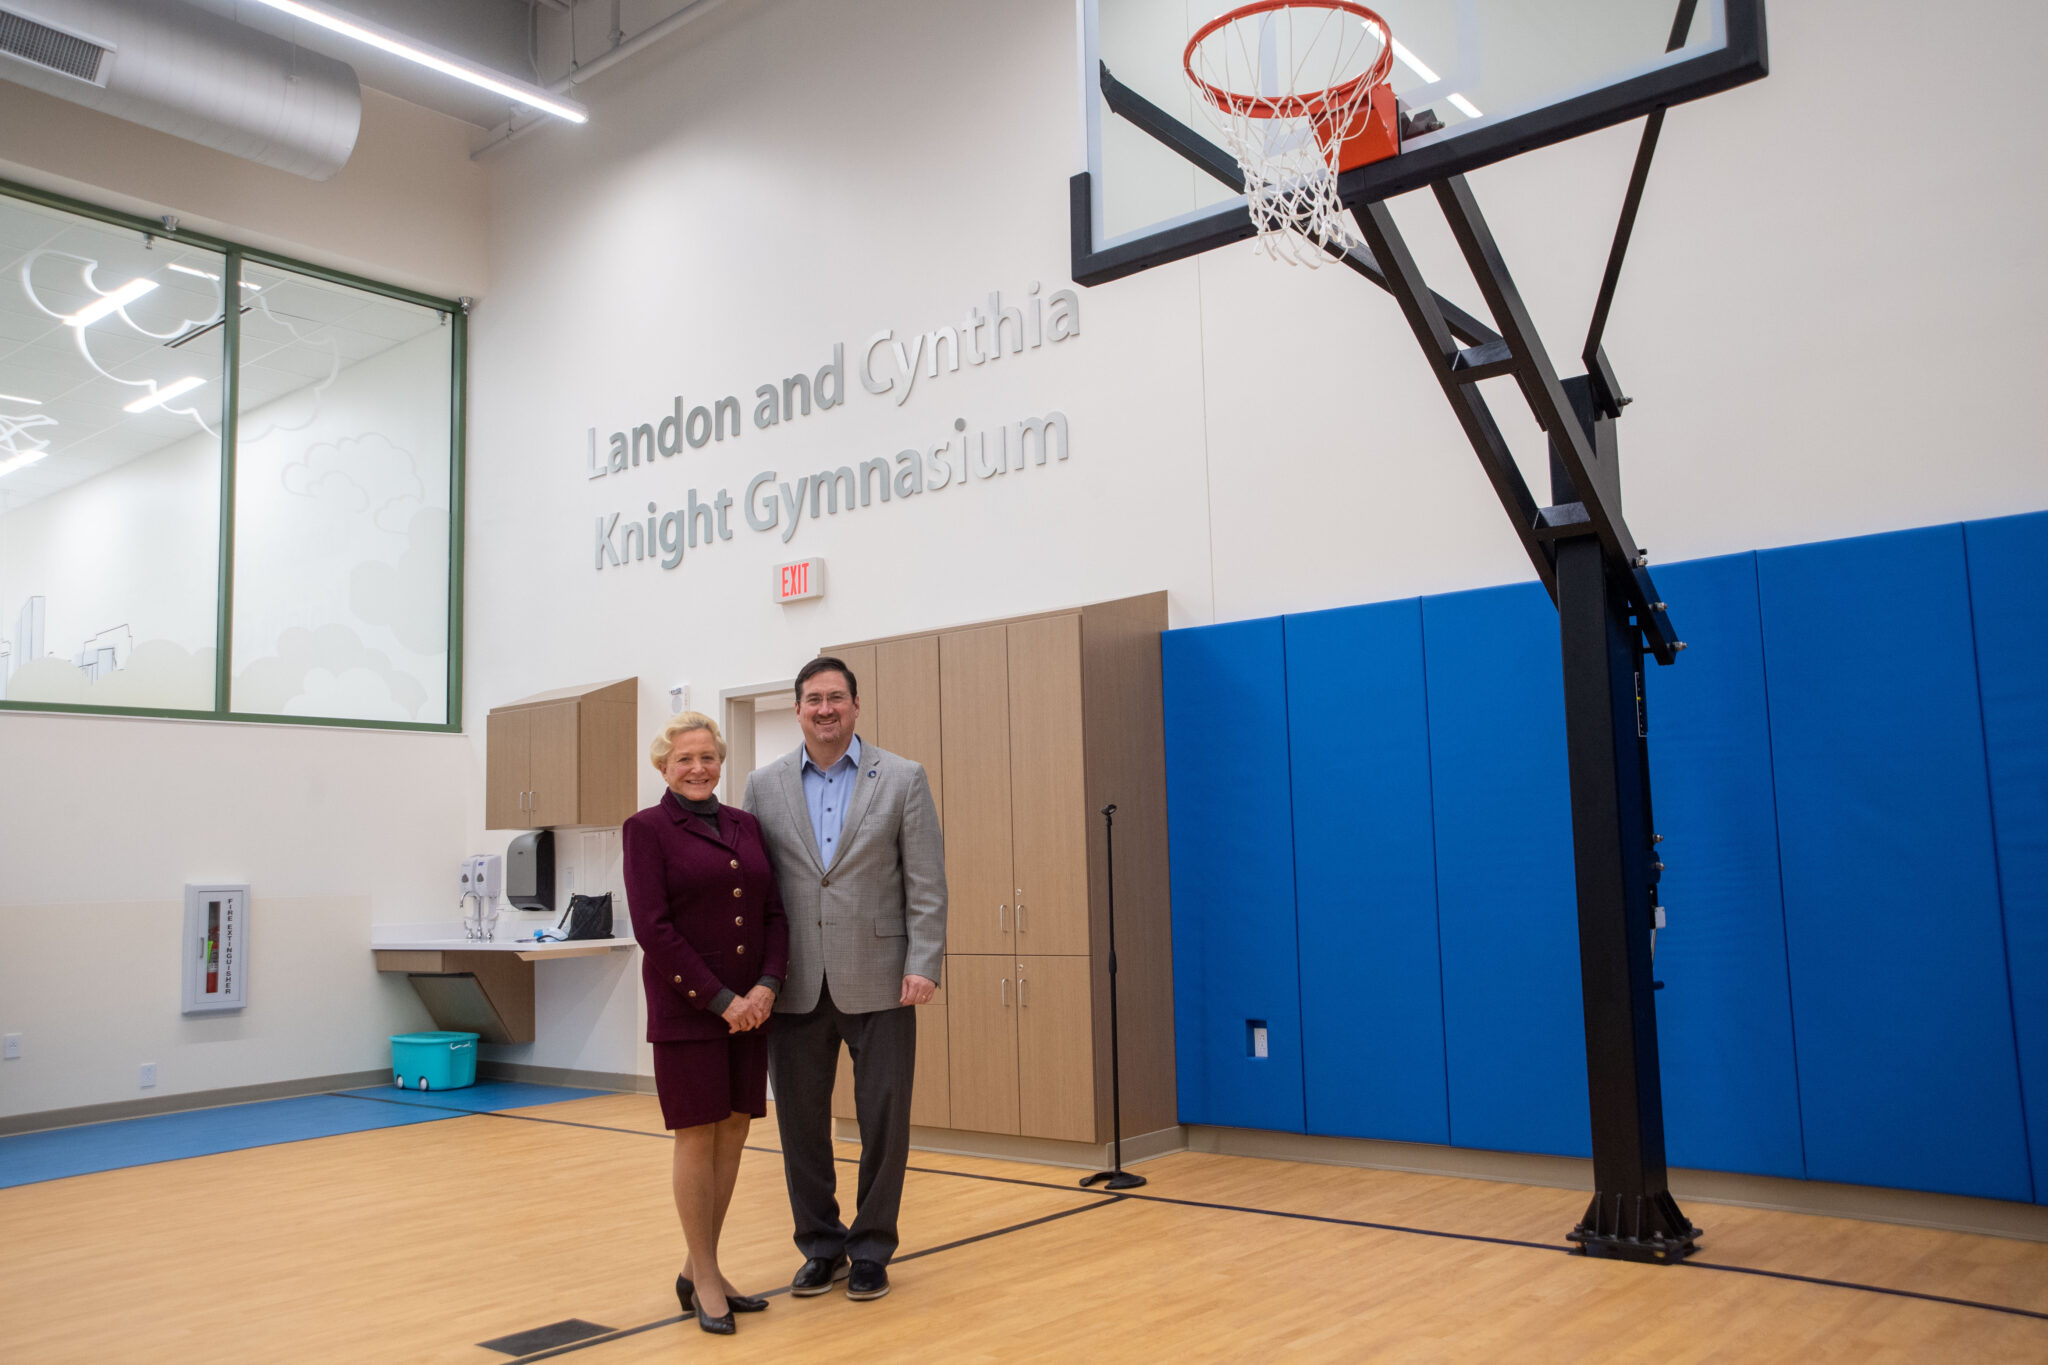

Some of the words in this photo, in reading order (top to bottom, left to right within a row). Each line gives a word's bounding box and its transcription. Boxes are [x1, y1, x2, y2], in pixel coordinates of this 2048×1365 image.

[587, 395, 740, 480] Landon
[753, 341, 844, 430] and
[859, 280, 1080, 406] Cynthia
[594, 488, 733, 570] Knight
[744, 411, 1068, 542] Gymnasium
[782, 562, 809, 597] EXIT
[225, 924, 233, 994] EXTINGUISHER
